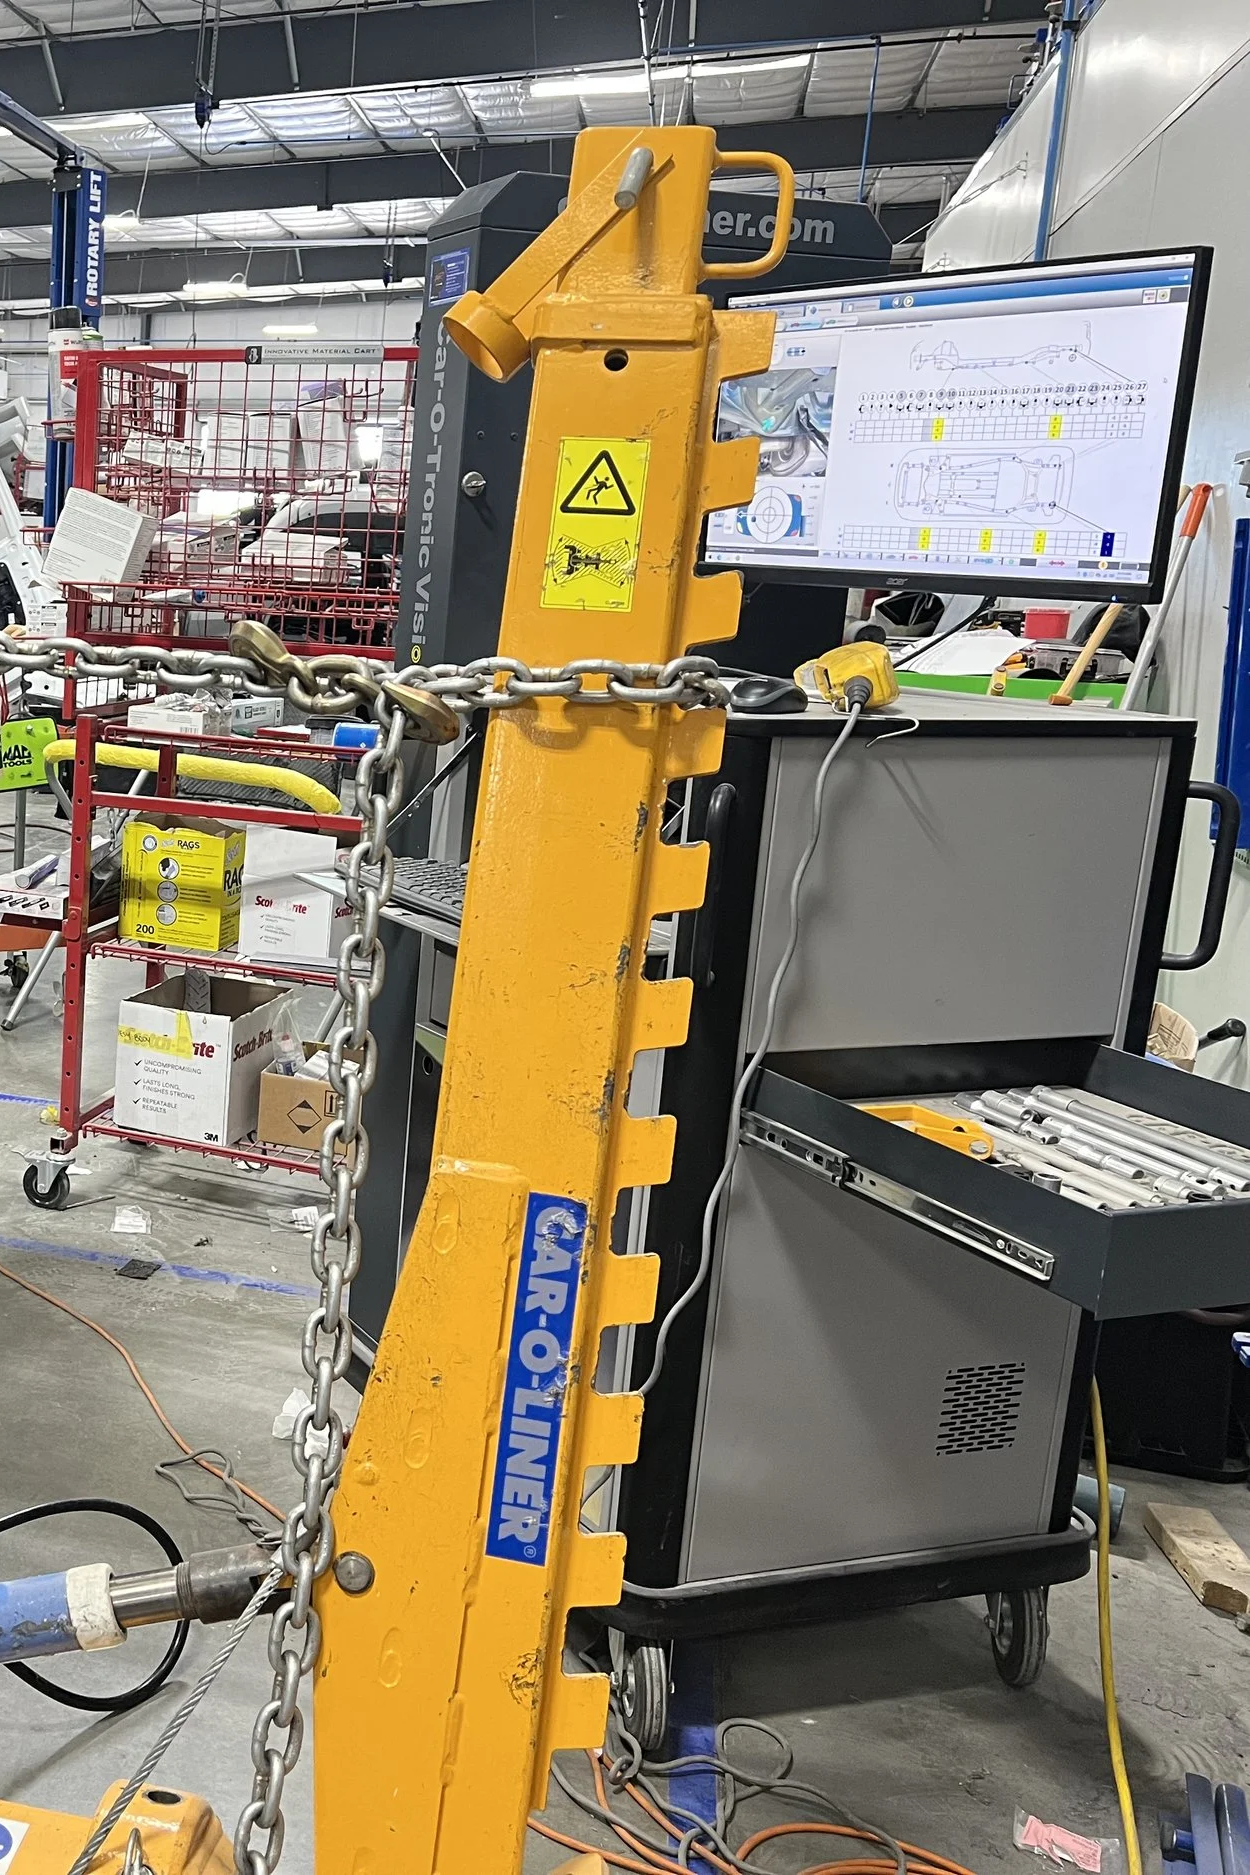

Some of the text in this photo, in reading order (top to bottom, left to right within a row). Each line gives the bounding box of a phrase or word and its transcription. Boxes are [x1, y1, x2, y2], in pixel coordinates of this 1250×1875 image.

[703, 207, 835, 244] er.com
[86, 170, 102, 297] ROTARY LIFT
[410, 572, 432, 664] Visio
[3, 759, 33, 768] TOOLS
[177, 839, 201, 850] RAGS
[223, 863, 244, 892] RA
[254, 895, 308, 914] Scotrite
[135, 923, 155, 935] 200
[232, 1028, 273, 1062] Scotch-Brit
[143, 1059, 202, 1075] UNCOMPROMISING
[143, 1066, 169, 1076] QUALITY
[142, 1078, 161, 1087] LASTS
[142, 1085, 196, 1100] FINISHES STRONG
[141, 1105, 167, 1114] RESULTS
[142, 1097, 178, 1110] REPEATABLE
[204, 1132, 219, 1142] 3M
